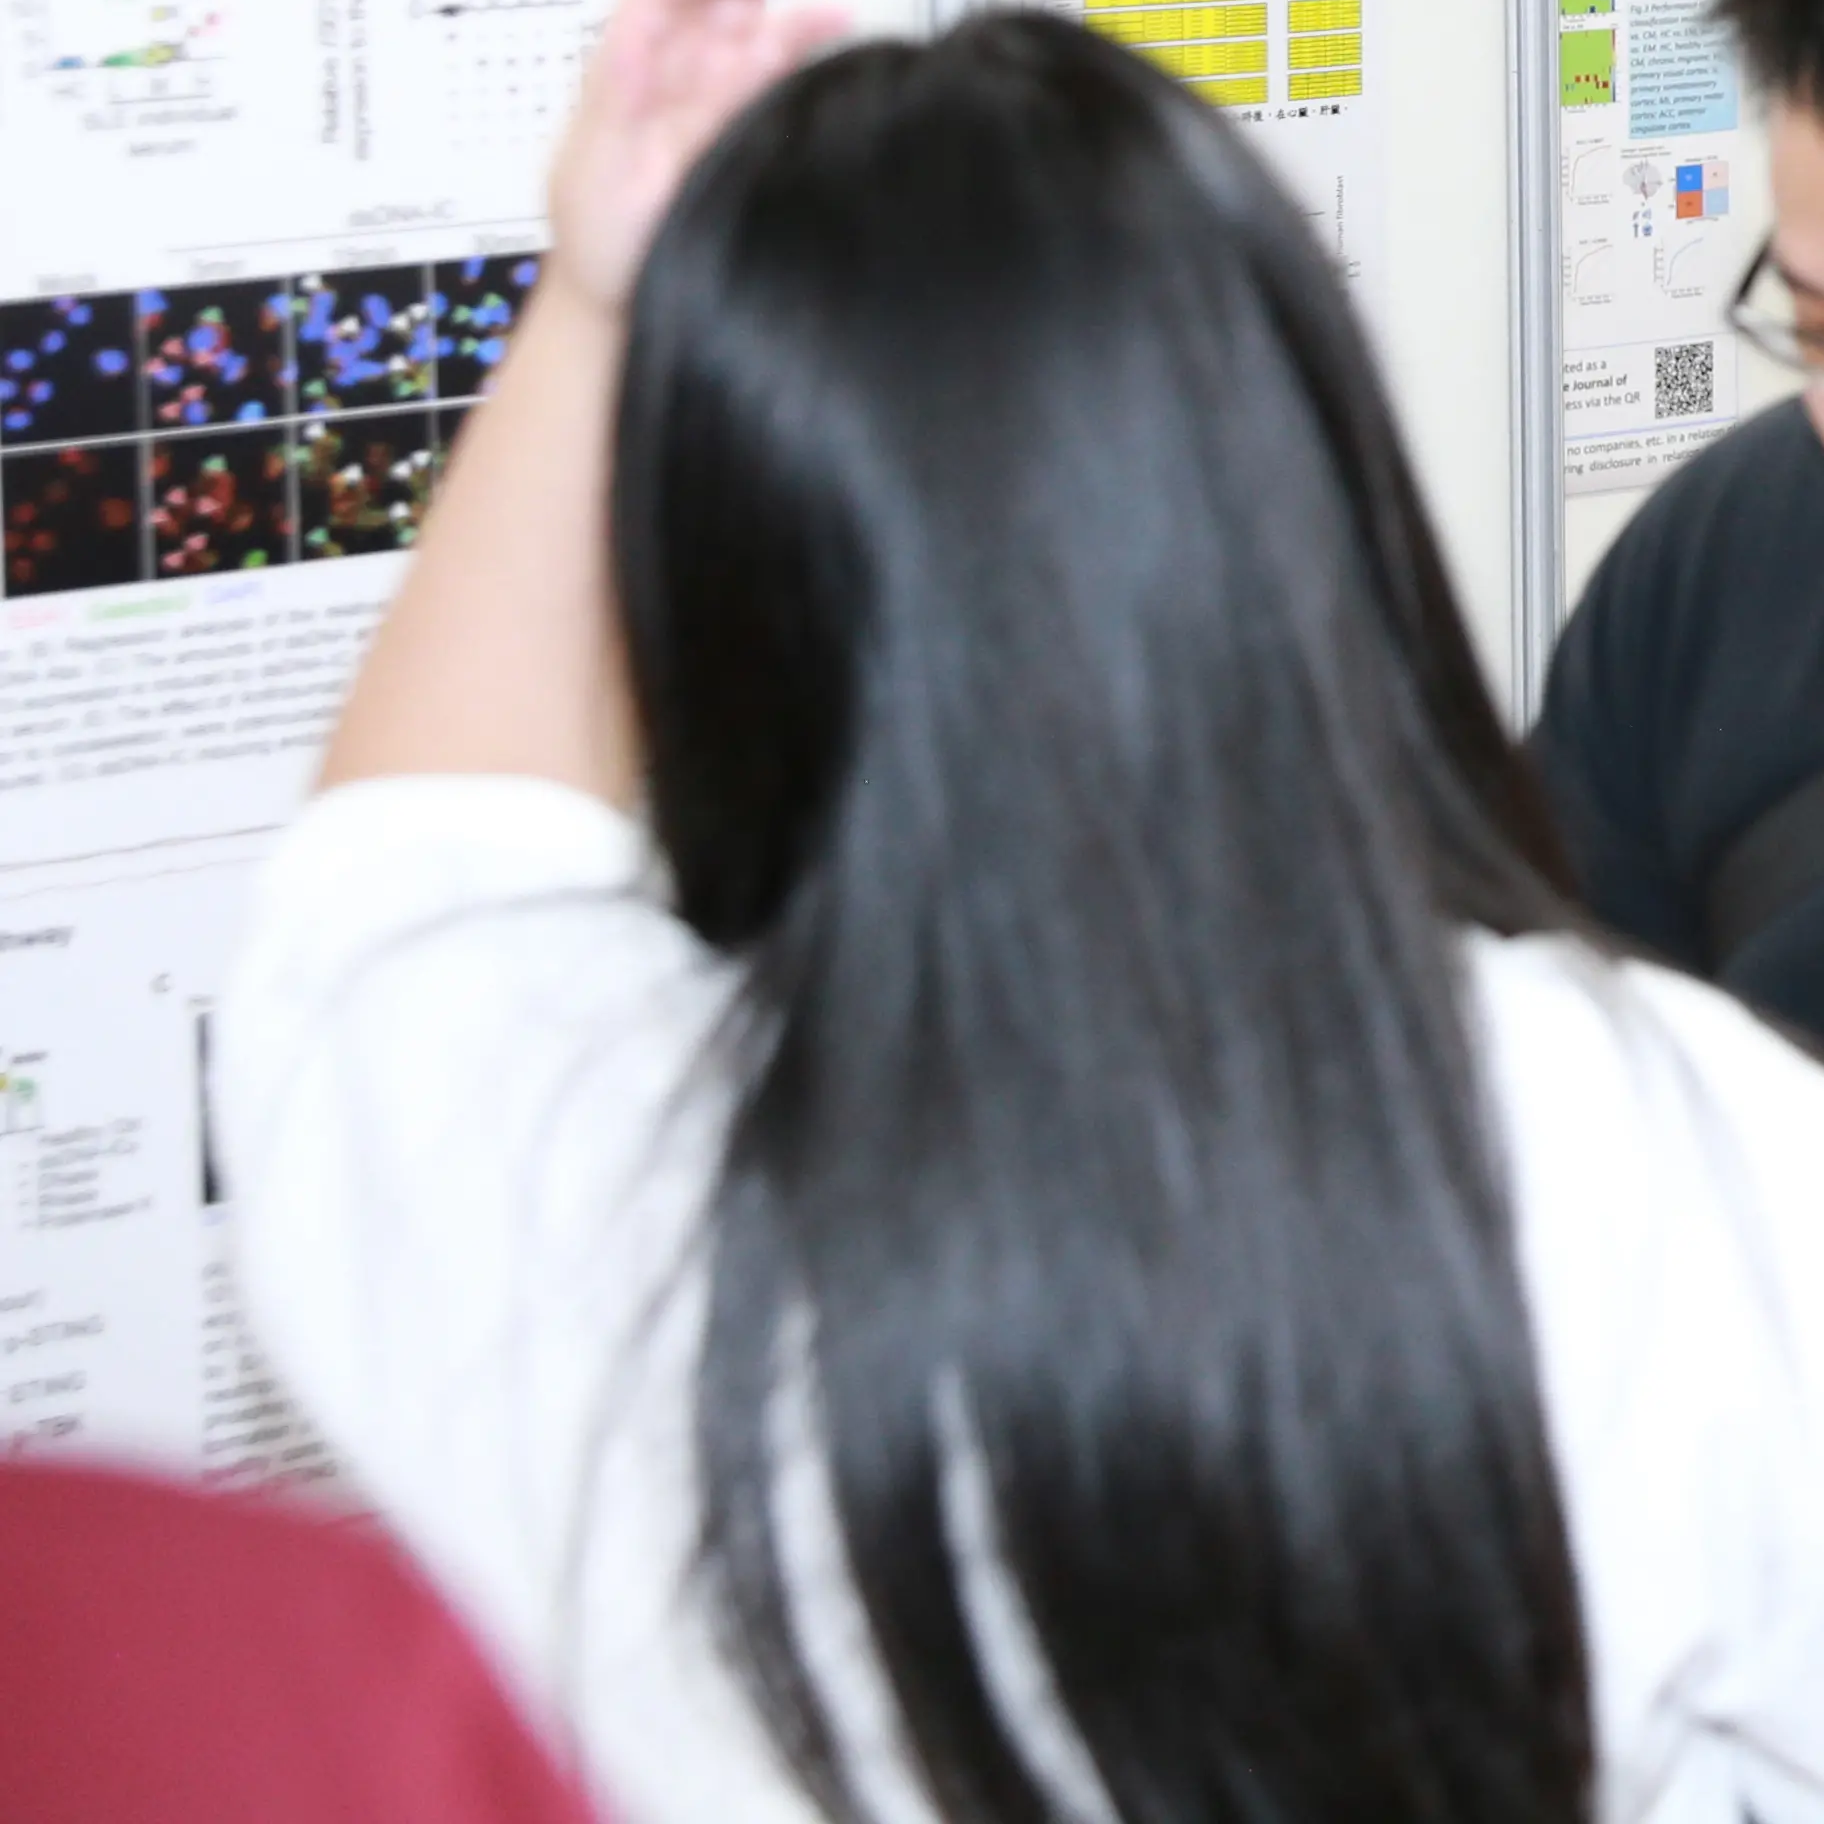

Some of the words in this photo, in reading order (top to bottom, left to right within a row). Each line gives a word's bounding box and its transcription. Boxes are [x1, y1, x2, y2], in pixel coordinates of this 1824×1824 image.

[1585, 362, 1598, 372] as
[1572, 377, 1613, 391] Journal
[1616, 374, 1627, 387] of
[1588, 397, 1601, 409] via
[1603, 393, 1622, 407] the
[1624, 391, 1641, 407] QR
[1567, 445, 1580, 457] no
[1583, 439, 1642, 457] companies,
[1590, 457, 1642, 473] disclosure
